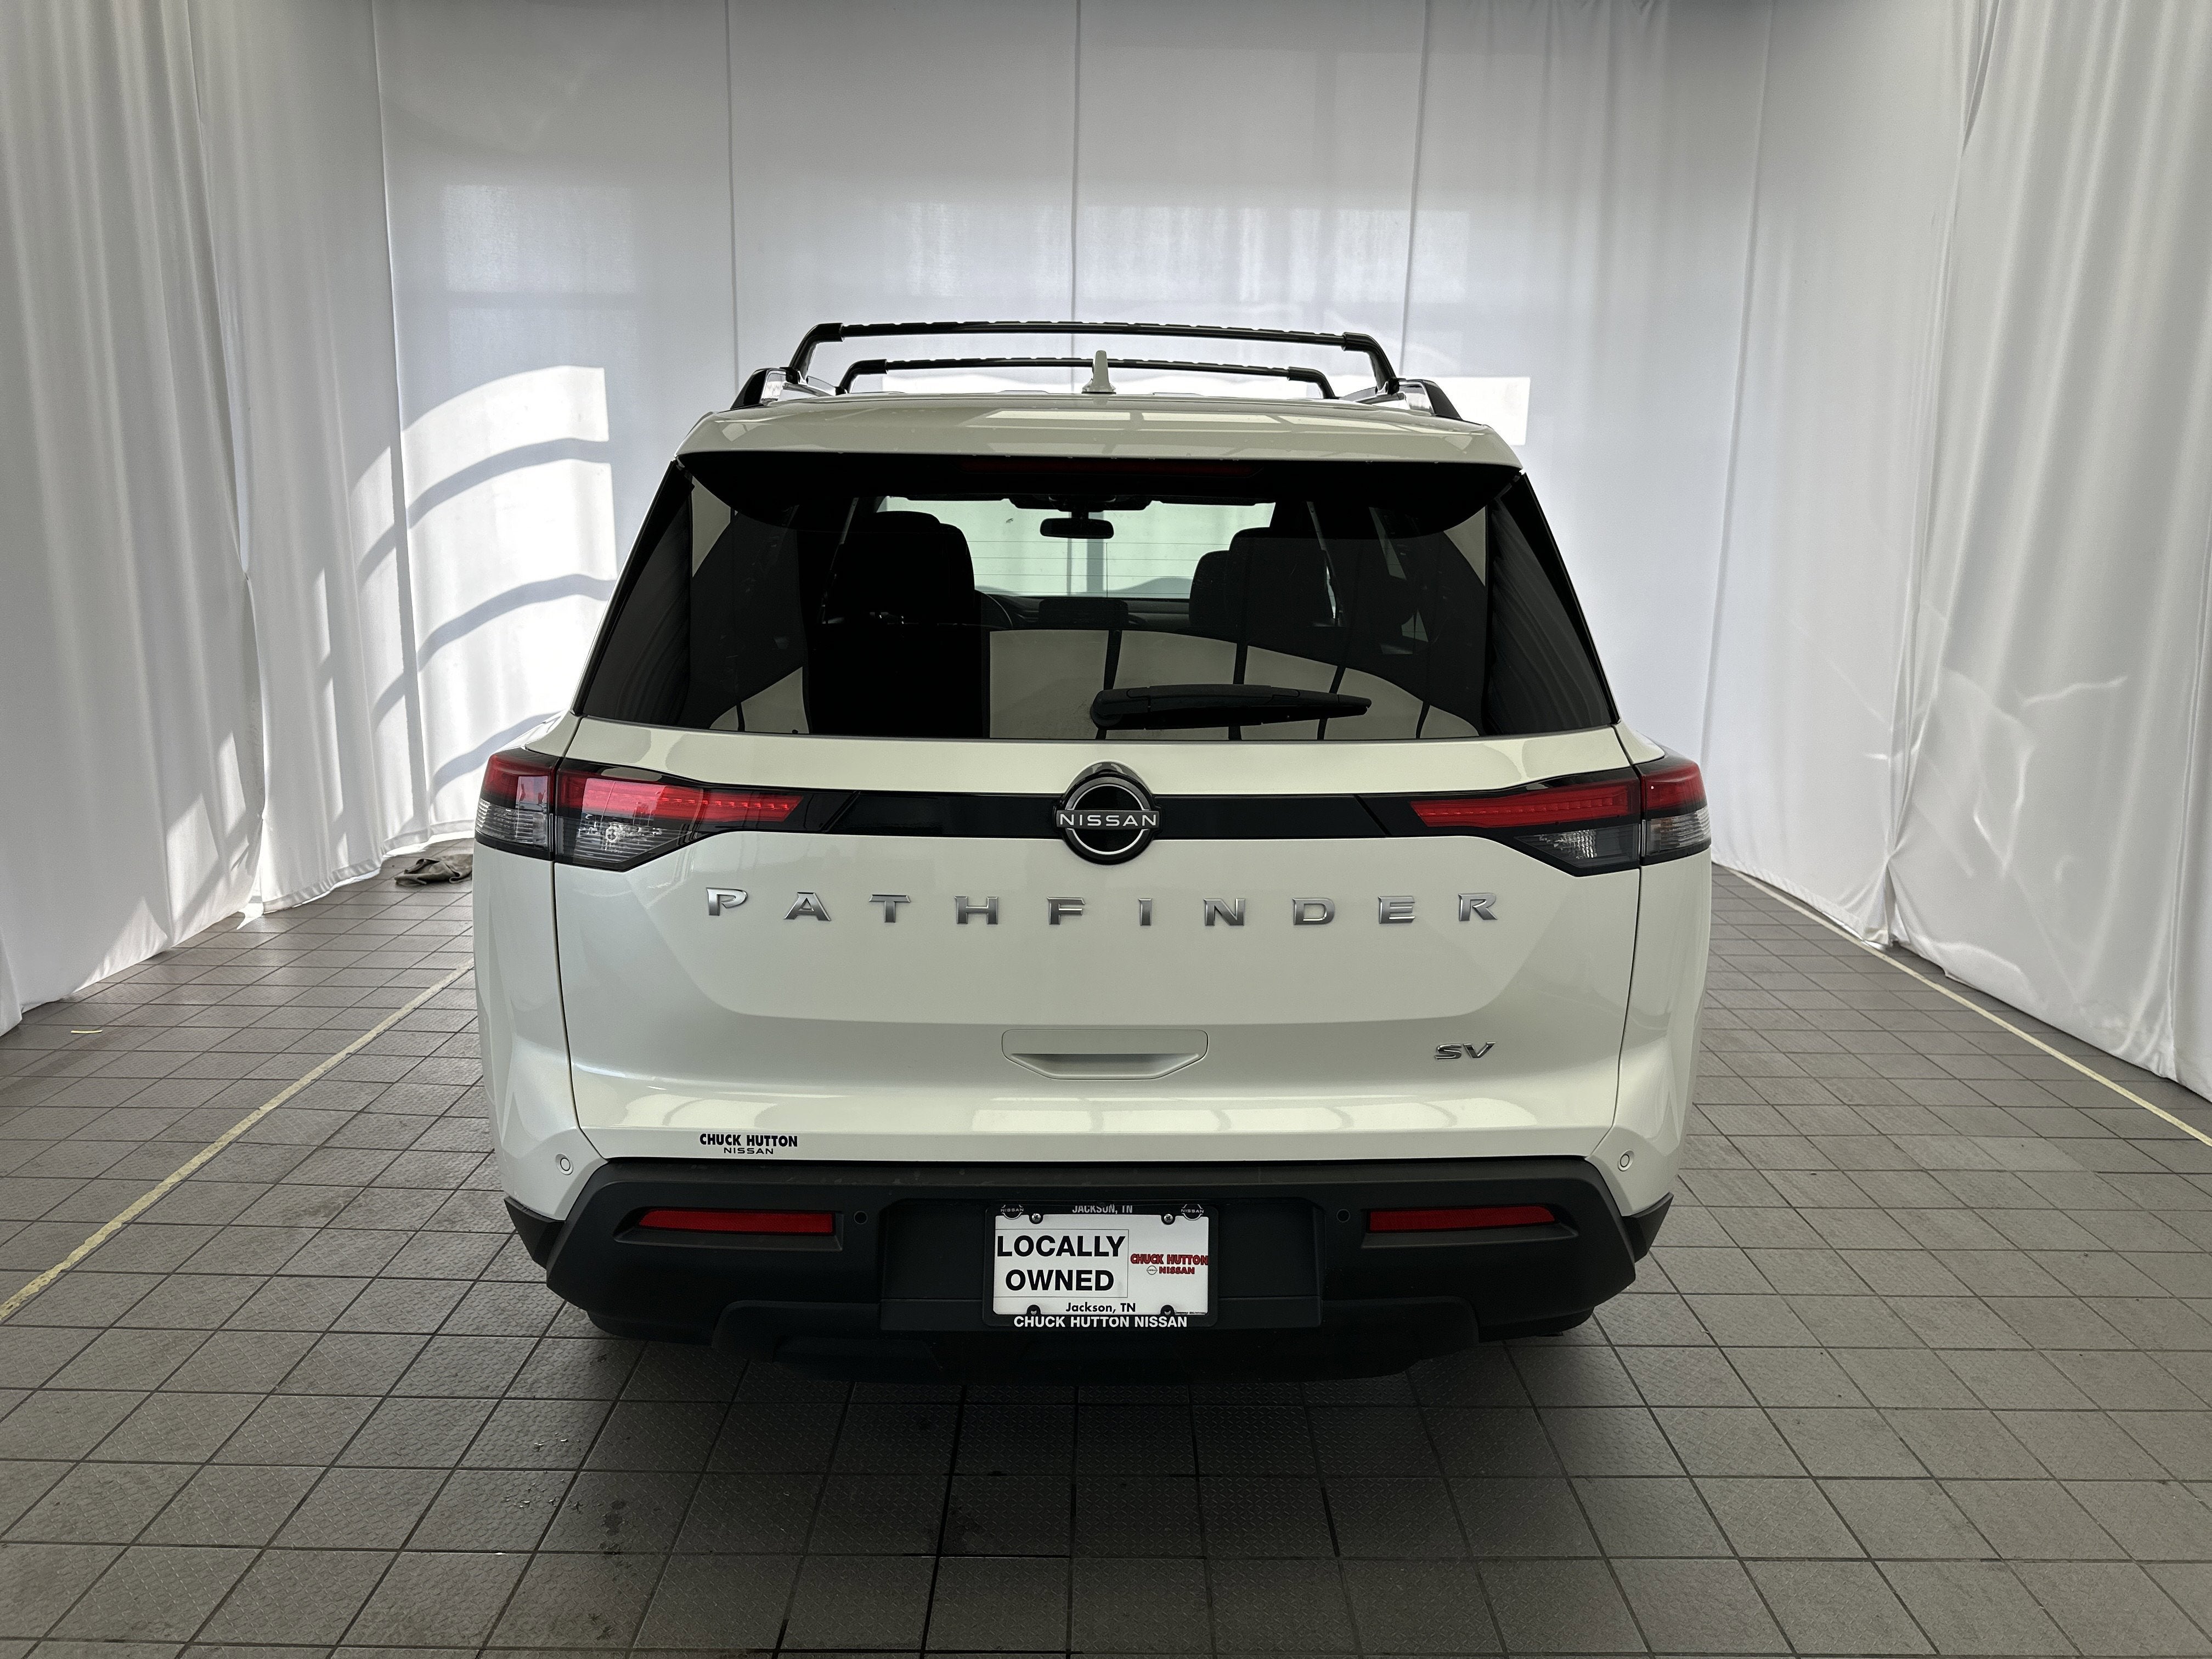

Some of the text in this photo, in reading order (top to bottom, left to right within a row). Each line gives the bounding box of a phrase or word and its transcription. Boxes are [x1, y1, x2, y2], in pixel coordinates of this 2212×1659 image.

[1060, 814, 1156, 827] NISSAN
[706, 887, 1498, 926] PATHFINDER
[1434, 1041, 1496, 1060] SV
[699, 1133, 798, 1147] CHUCK HUTTON
[997, 1235, 1126, 1257] LOCALLY
[1130, 1254, 1208, 1265] CHUCK HUTTON
[1159, 1266, 1195, 1274] NISSAN
[1005, 1269, 1114, 1291] OWNED
[1065, 1302, 1136, 1313] Jackson, TN
[1014, 1316, 1187, 1327] CHUCK HUTTON NISSAN
